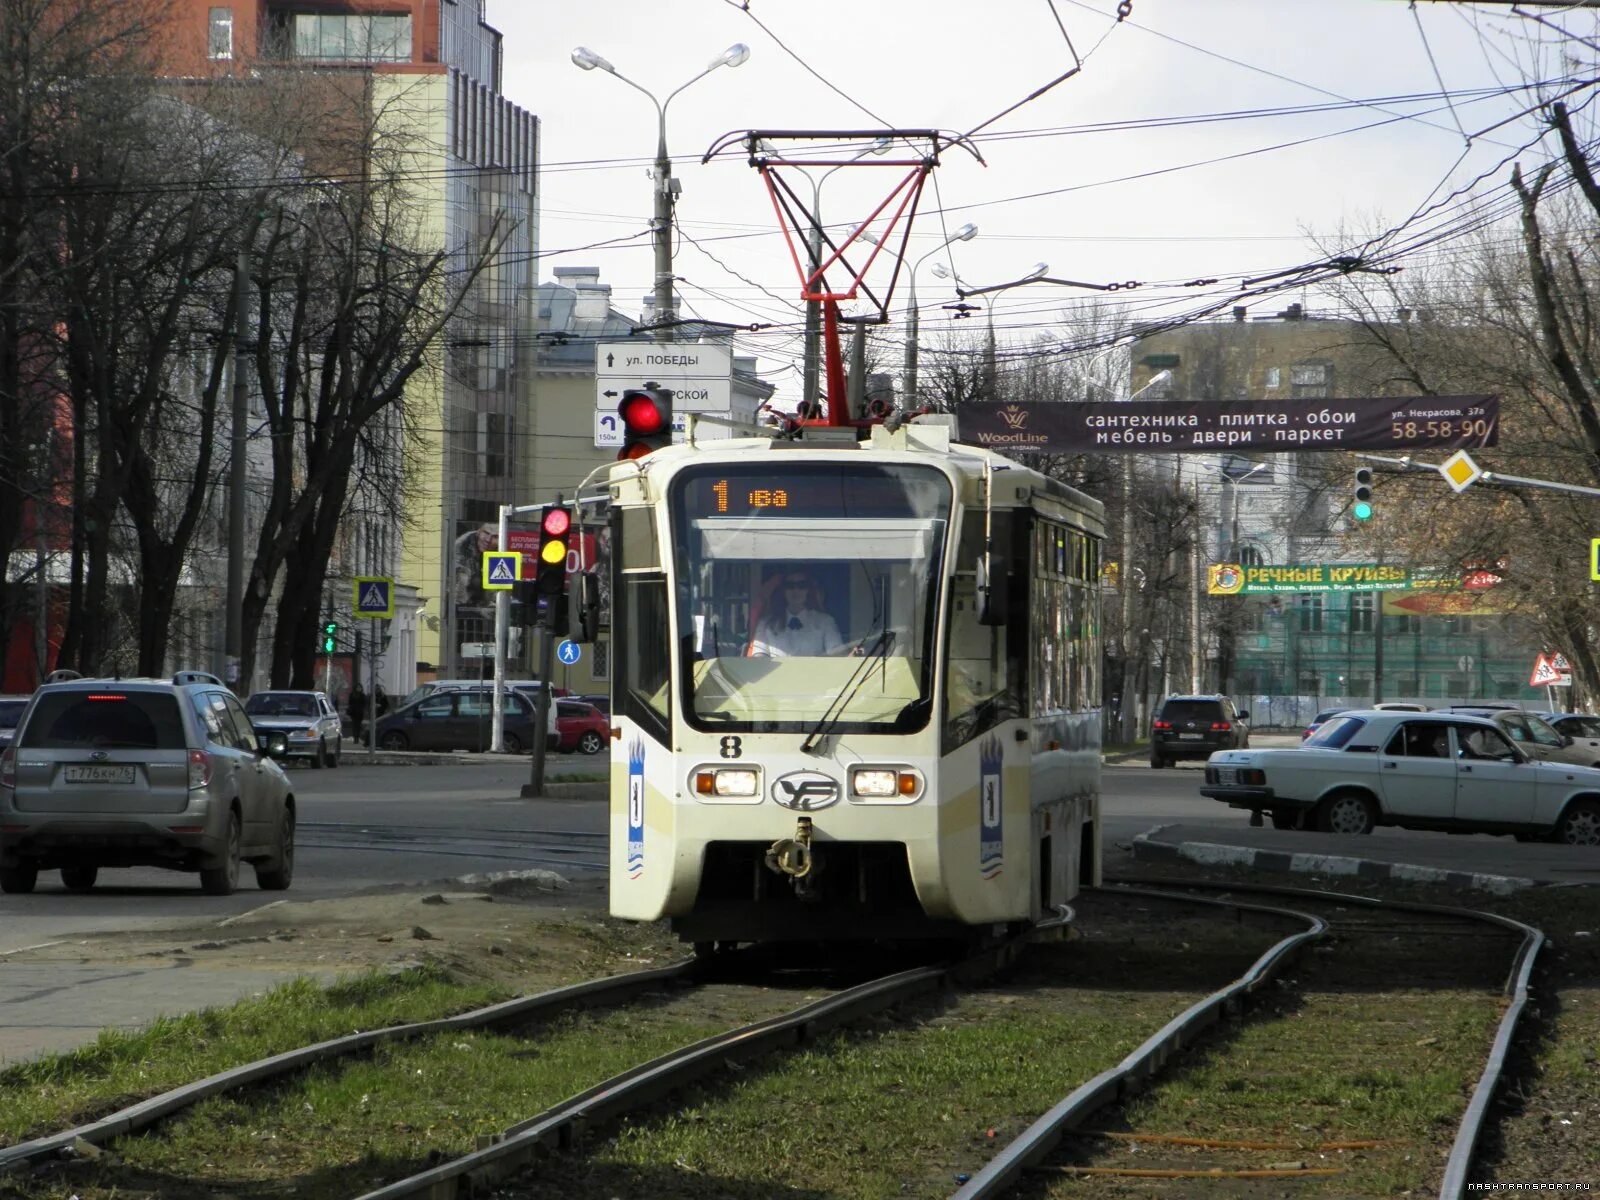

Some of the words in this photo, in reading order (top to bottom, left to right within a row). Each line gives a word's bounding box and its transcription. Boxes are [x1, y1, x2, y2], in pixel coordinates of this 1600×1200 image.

[626, 357, 643, 367] ул.
[646, 355, 699, 366] ПОБЕДЫ
[1085, 414, 1198, 427] сантехника
[1219, 411, 1288, 426] плитка
[1306, 408, 1357, 424] обои
[1409, 409, 1464, 418] Некрасова,
[977, 432, 1049, 443] WoodLine
[1096, 428, 1173, 444] мебель
[1192, 430, 1252, 446] двери
[1275, 427, 1344, 444] паркет
[1391, 419, 1487, 439] 58-58-90
[712, 480, 728, 512] 1
[1247, 568, 1323, 582] РЕЧНЫЕ
[1330, 566, 1406, 581] КРУИЗЫ
[719, 735, 743, 759] 8
